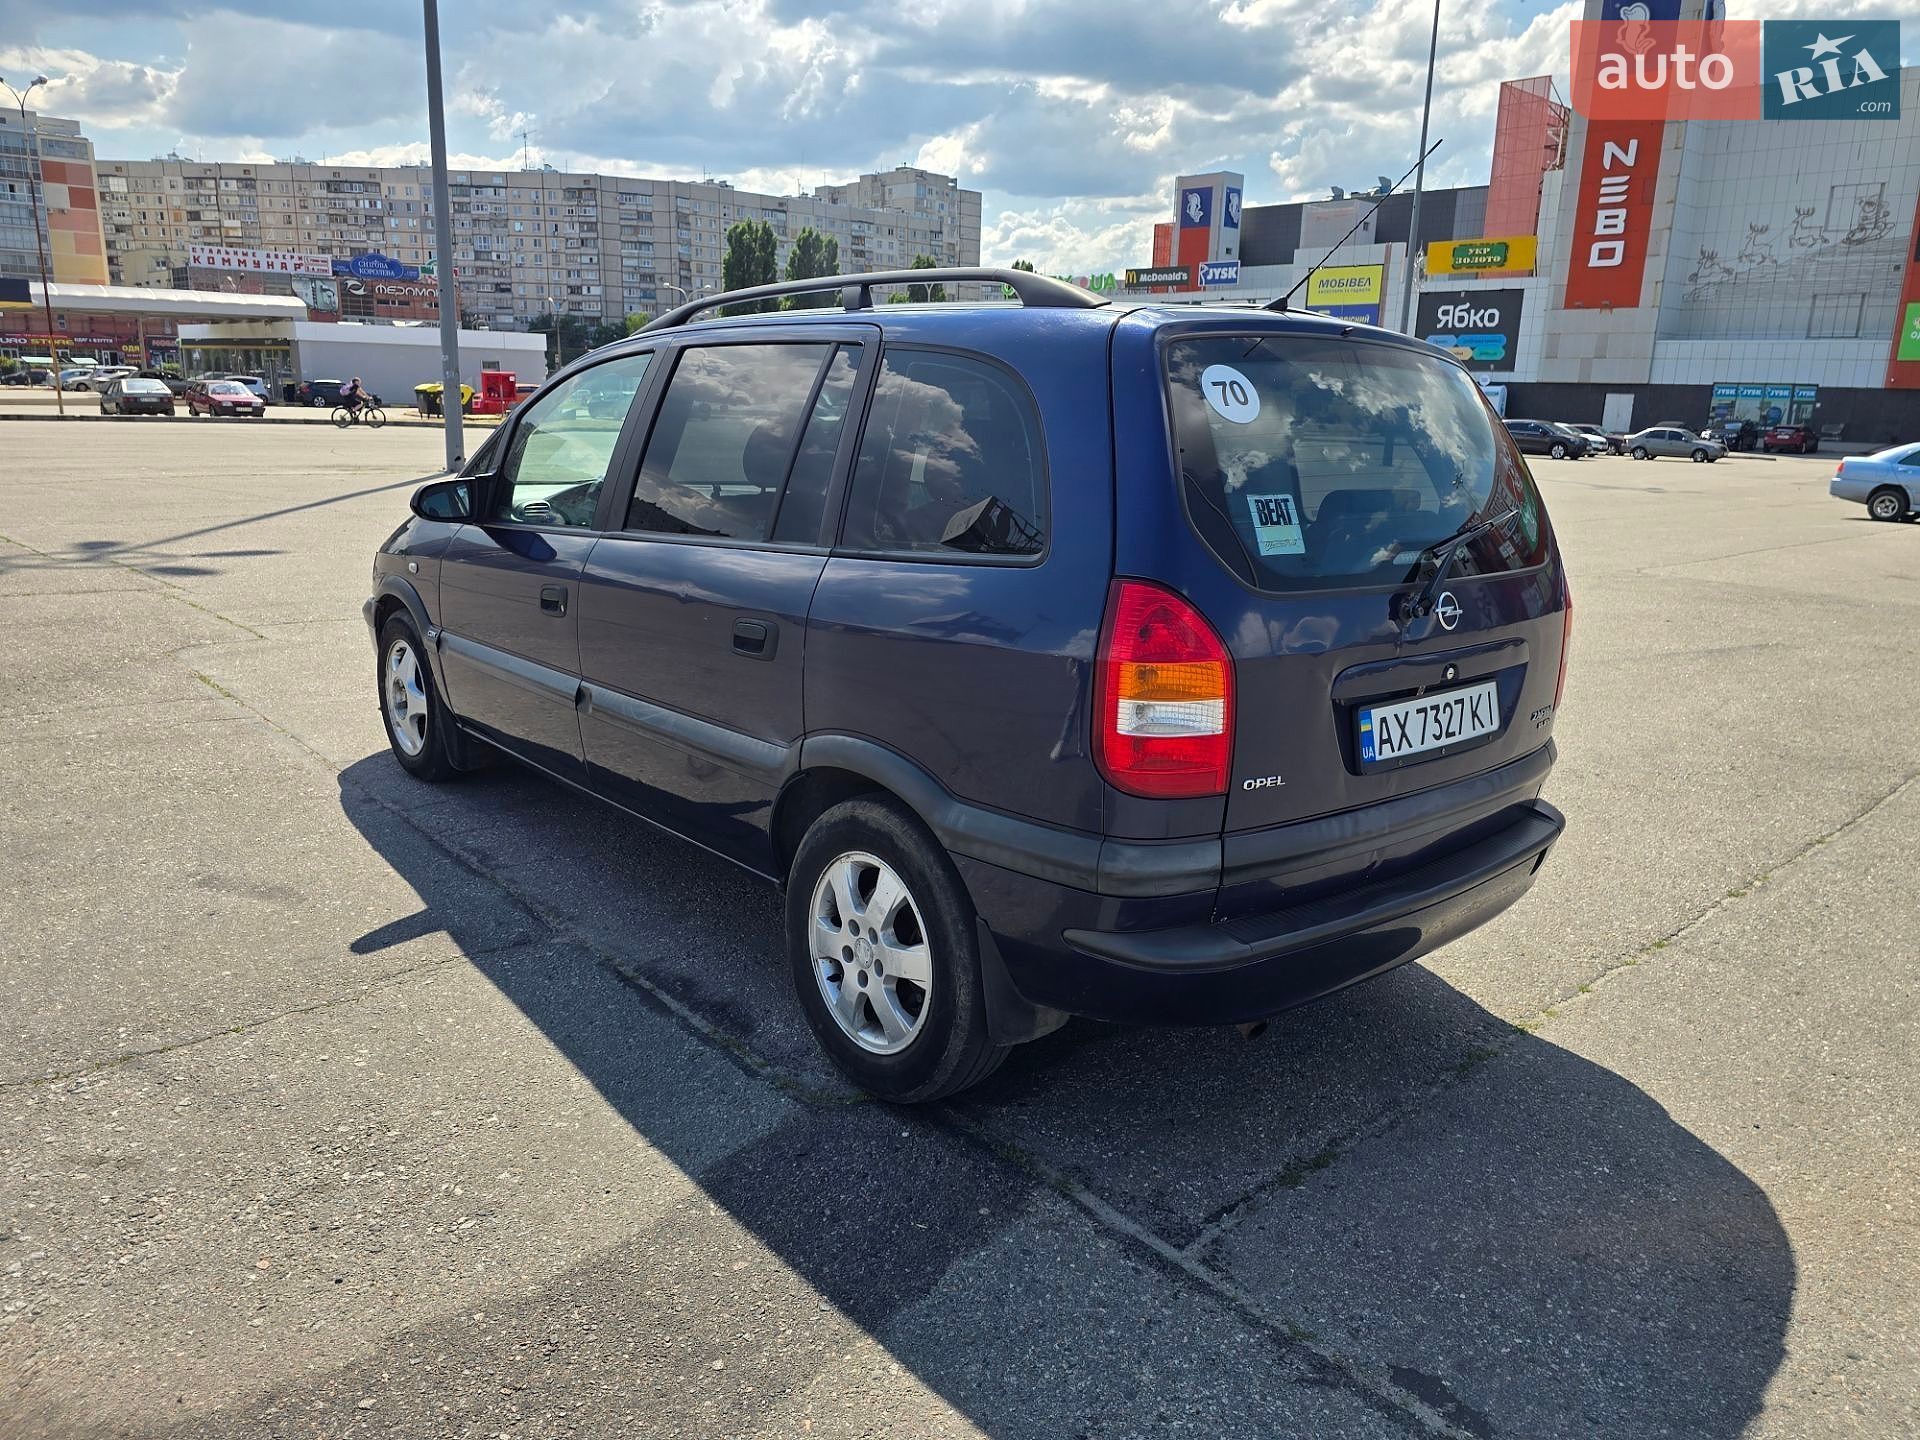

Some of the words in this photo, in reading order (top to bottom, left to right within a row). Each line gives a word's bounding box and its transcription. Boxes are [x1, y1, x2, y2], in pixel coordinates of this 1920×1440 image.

[1587, 138, 1638, 268] NEBO
[1468, 247, 1491, 255] УКР
[193, 255, 304, 271] КОММУНАР
[1455, 255, 1501, 264] ЗОЛОТО
[1139, 271, 1188, 282] McDonald's
[1206, 267, 1237, 280] JYSK
[1318, 277, 1371, 289] МОБІВЕЛ
[1437, 302, 1500, 328] Ябко
[1211, 380, 1249, 407] 70
[1254, 498, 1294, 526] BEAT
[1362, 746, 1375, 759] UA
[1243, 775, 1286, 791] OPEL
